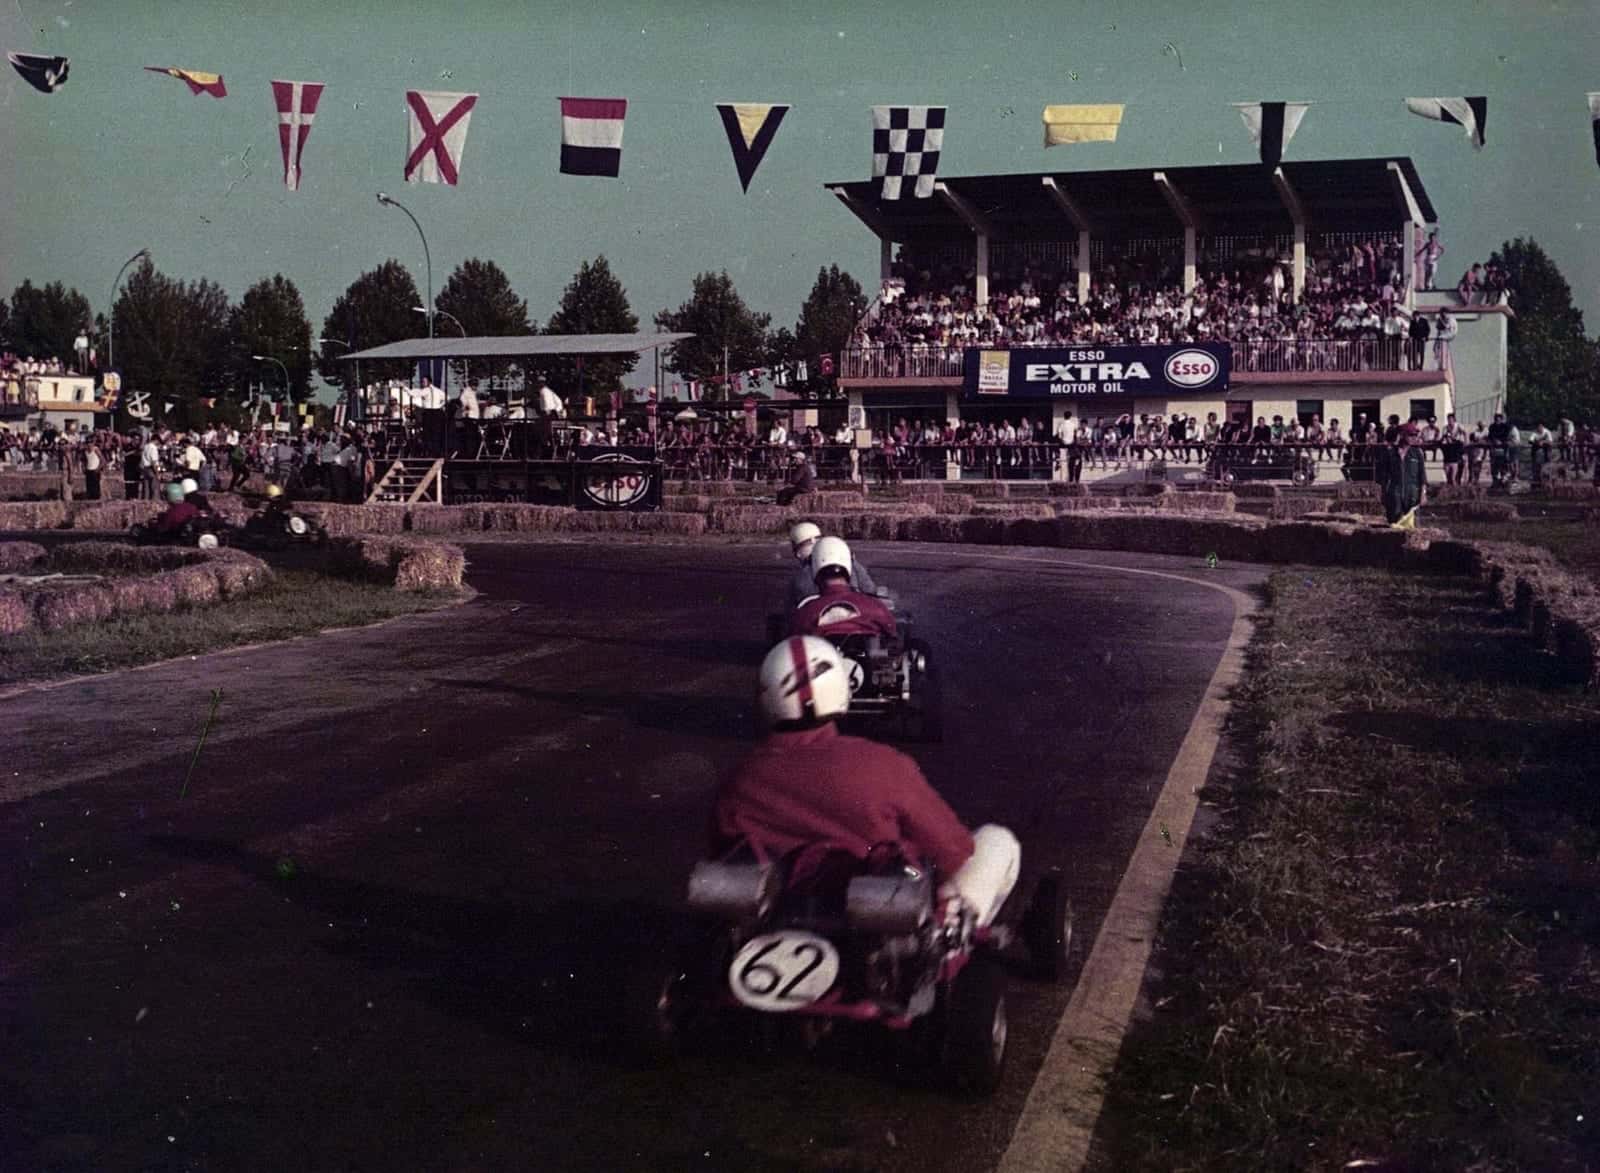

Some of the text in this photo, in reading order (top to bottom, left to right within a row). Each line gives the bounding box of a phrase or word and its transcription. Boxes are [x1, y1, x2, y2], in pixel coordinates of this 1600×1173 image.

[1069, 351, 1105, 361] ESSO
[1026, 362, 1151, 382] EXTRA
[1172, 360, 1211, 376] Esso
[1050, 382, 1124, 394] MOTOR OIL
[740, 937, 825, 1001] 62
